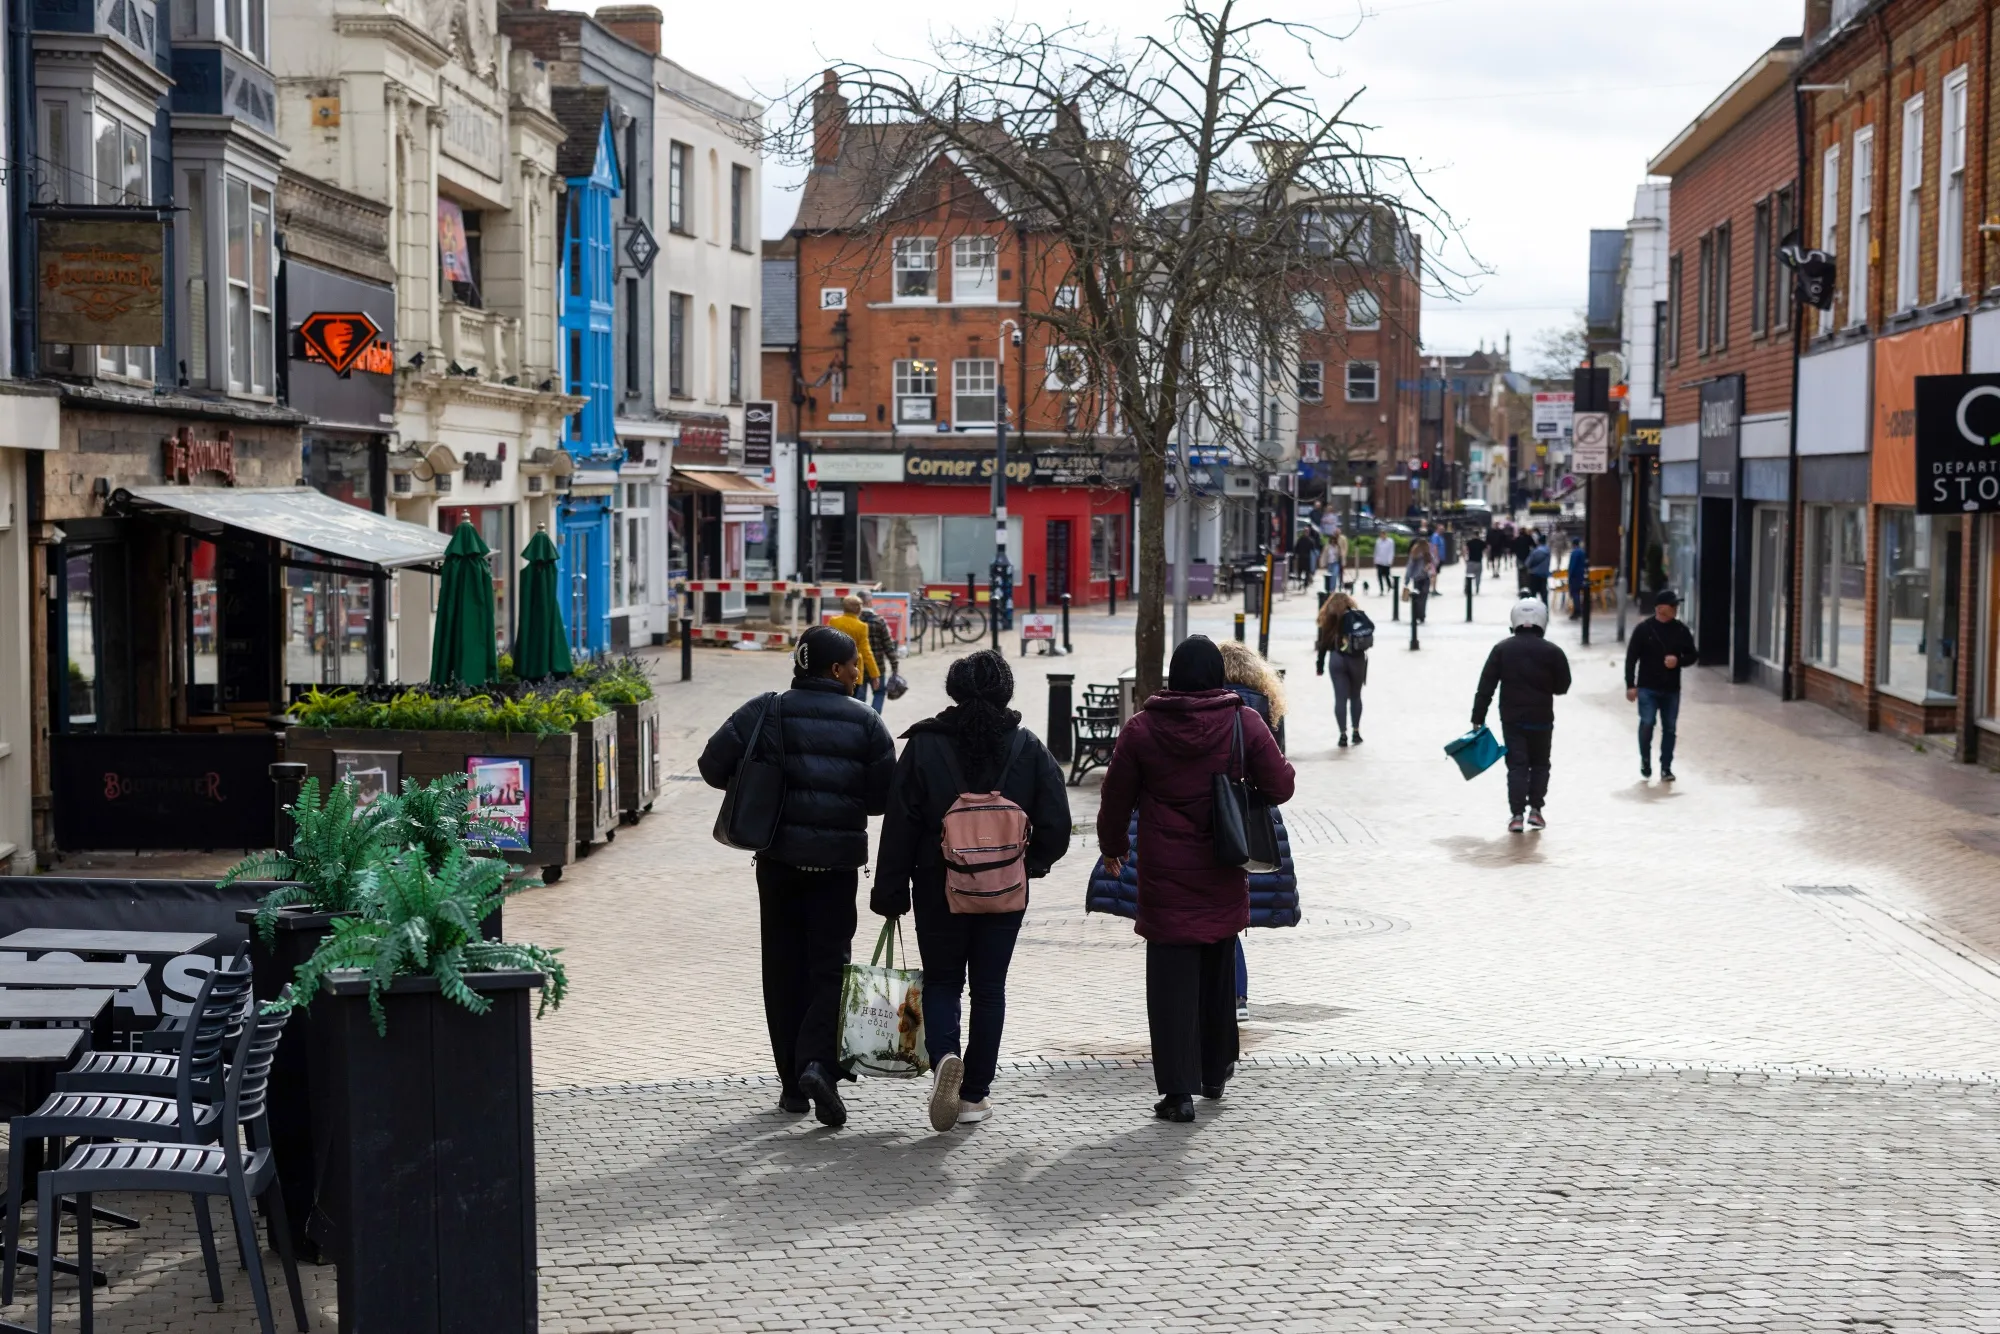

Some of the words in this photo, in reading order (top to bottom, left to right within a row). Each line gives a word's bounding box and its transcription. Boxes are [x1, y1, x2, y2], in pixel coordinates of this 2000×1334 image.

[906, 457, 976, 476] Corner
[1576, 462, 1604, 470] ENDS
[1932, 461, 2000, 474] DEPART
[103, 772, 227, 802] BOOTMAKER
[862, 1007, 893, 1019] HELLO
[875, 1029, 894, 1040] days
